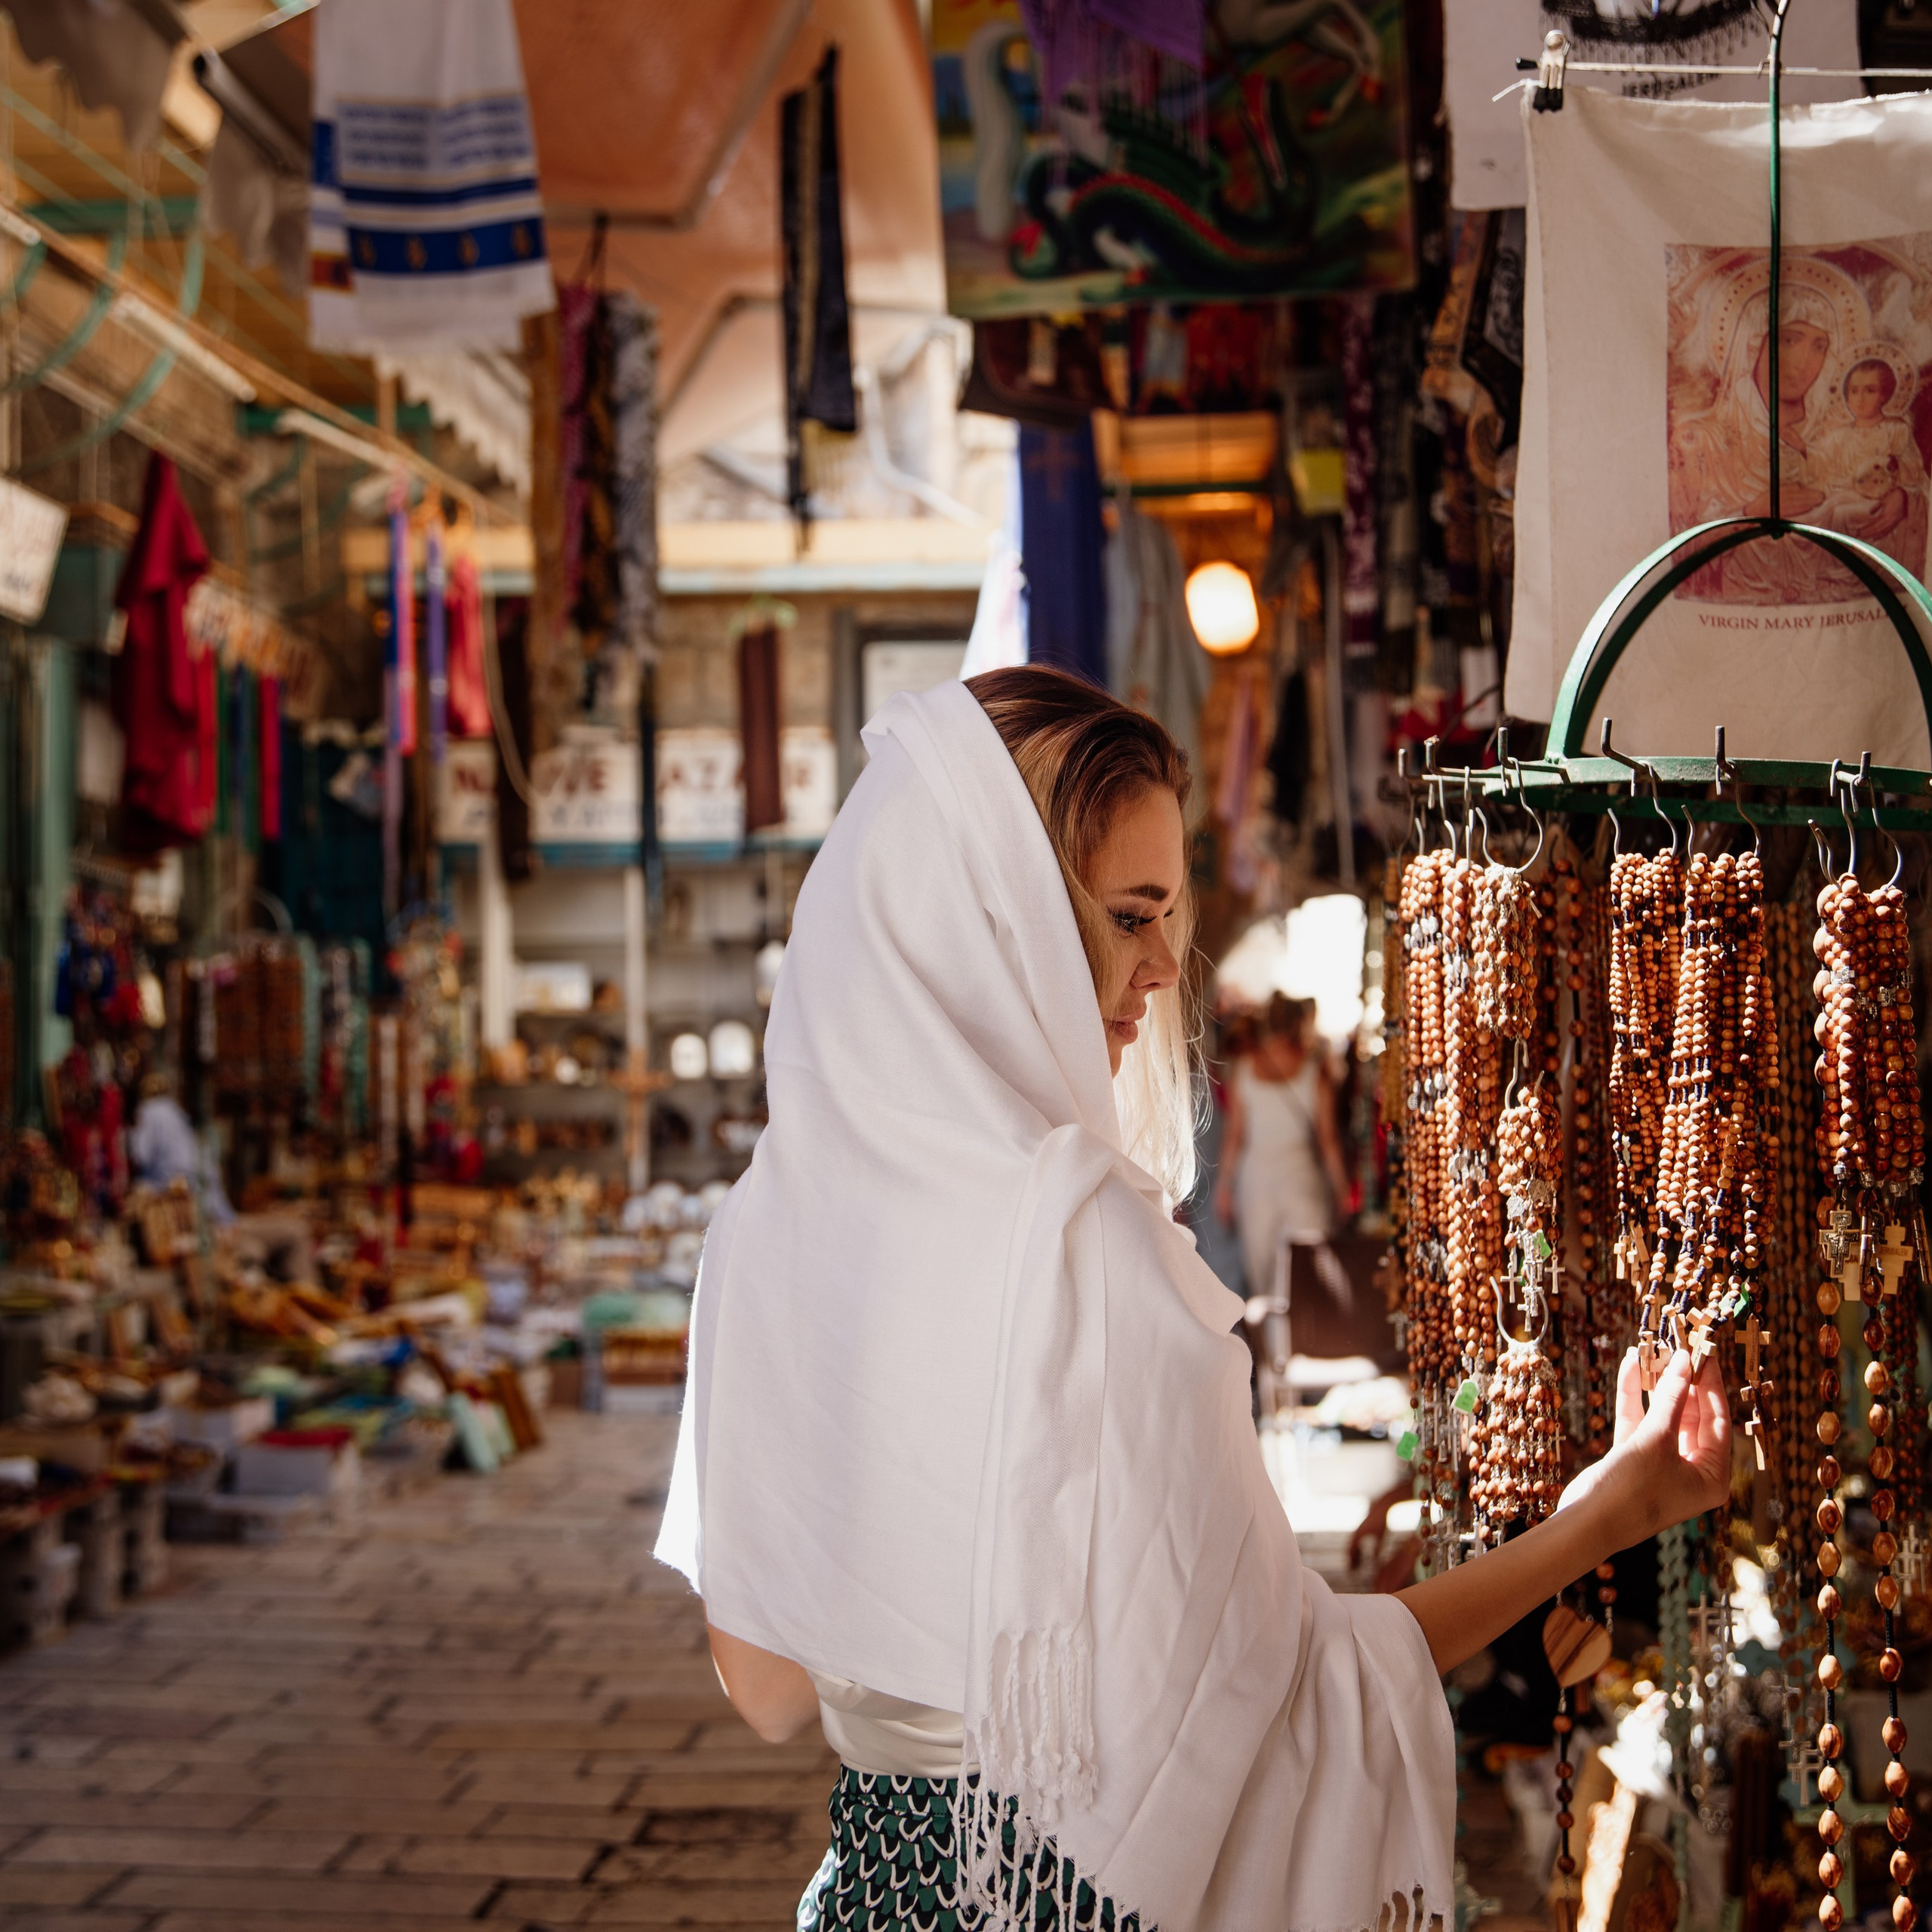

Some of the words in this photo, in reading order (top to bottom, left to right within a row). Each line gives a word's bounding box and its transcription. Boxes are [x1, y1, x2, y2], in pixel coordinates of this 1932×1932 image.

[1699, 614, 1759, 629] VIRGIN
[1764, 615, 1814, 629] MARY
[1820, 605, 1906, 628] JERUSAL
